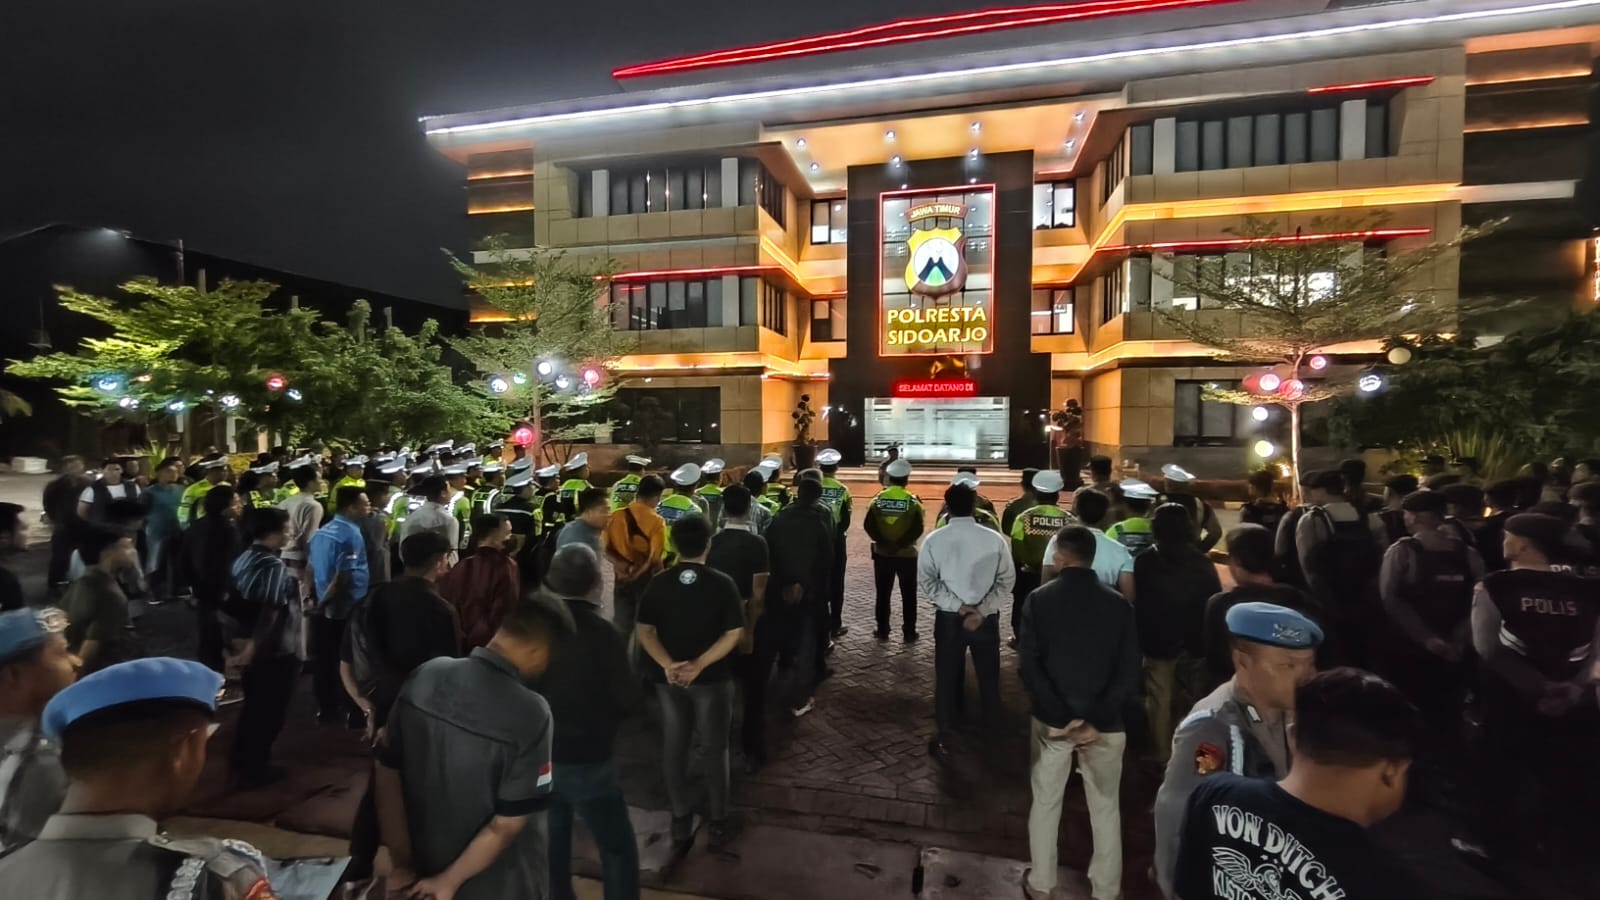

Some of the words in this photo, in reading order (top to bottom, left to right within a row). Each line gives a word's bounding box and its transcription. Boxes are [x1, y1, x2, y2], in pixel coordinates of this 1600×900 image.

[911, 206, 933, 218] JAWA
[934, 204, 961, 215] TIMUR
[887, 307, 987, 324] POLRESTA
[887, 327, 987, 344] SIDOARJO
[898, 383, 933, 392] SELAMAT
[965, 382, 974, 392] DI
[1032, 516, 1064, 527] POLISI
[1211, 805, 1263, 847] VON
[1263, 822, 1346, 900] DUTCH
